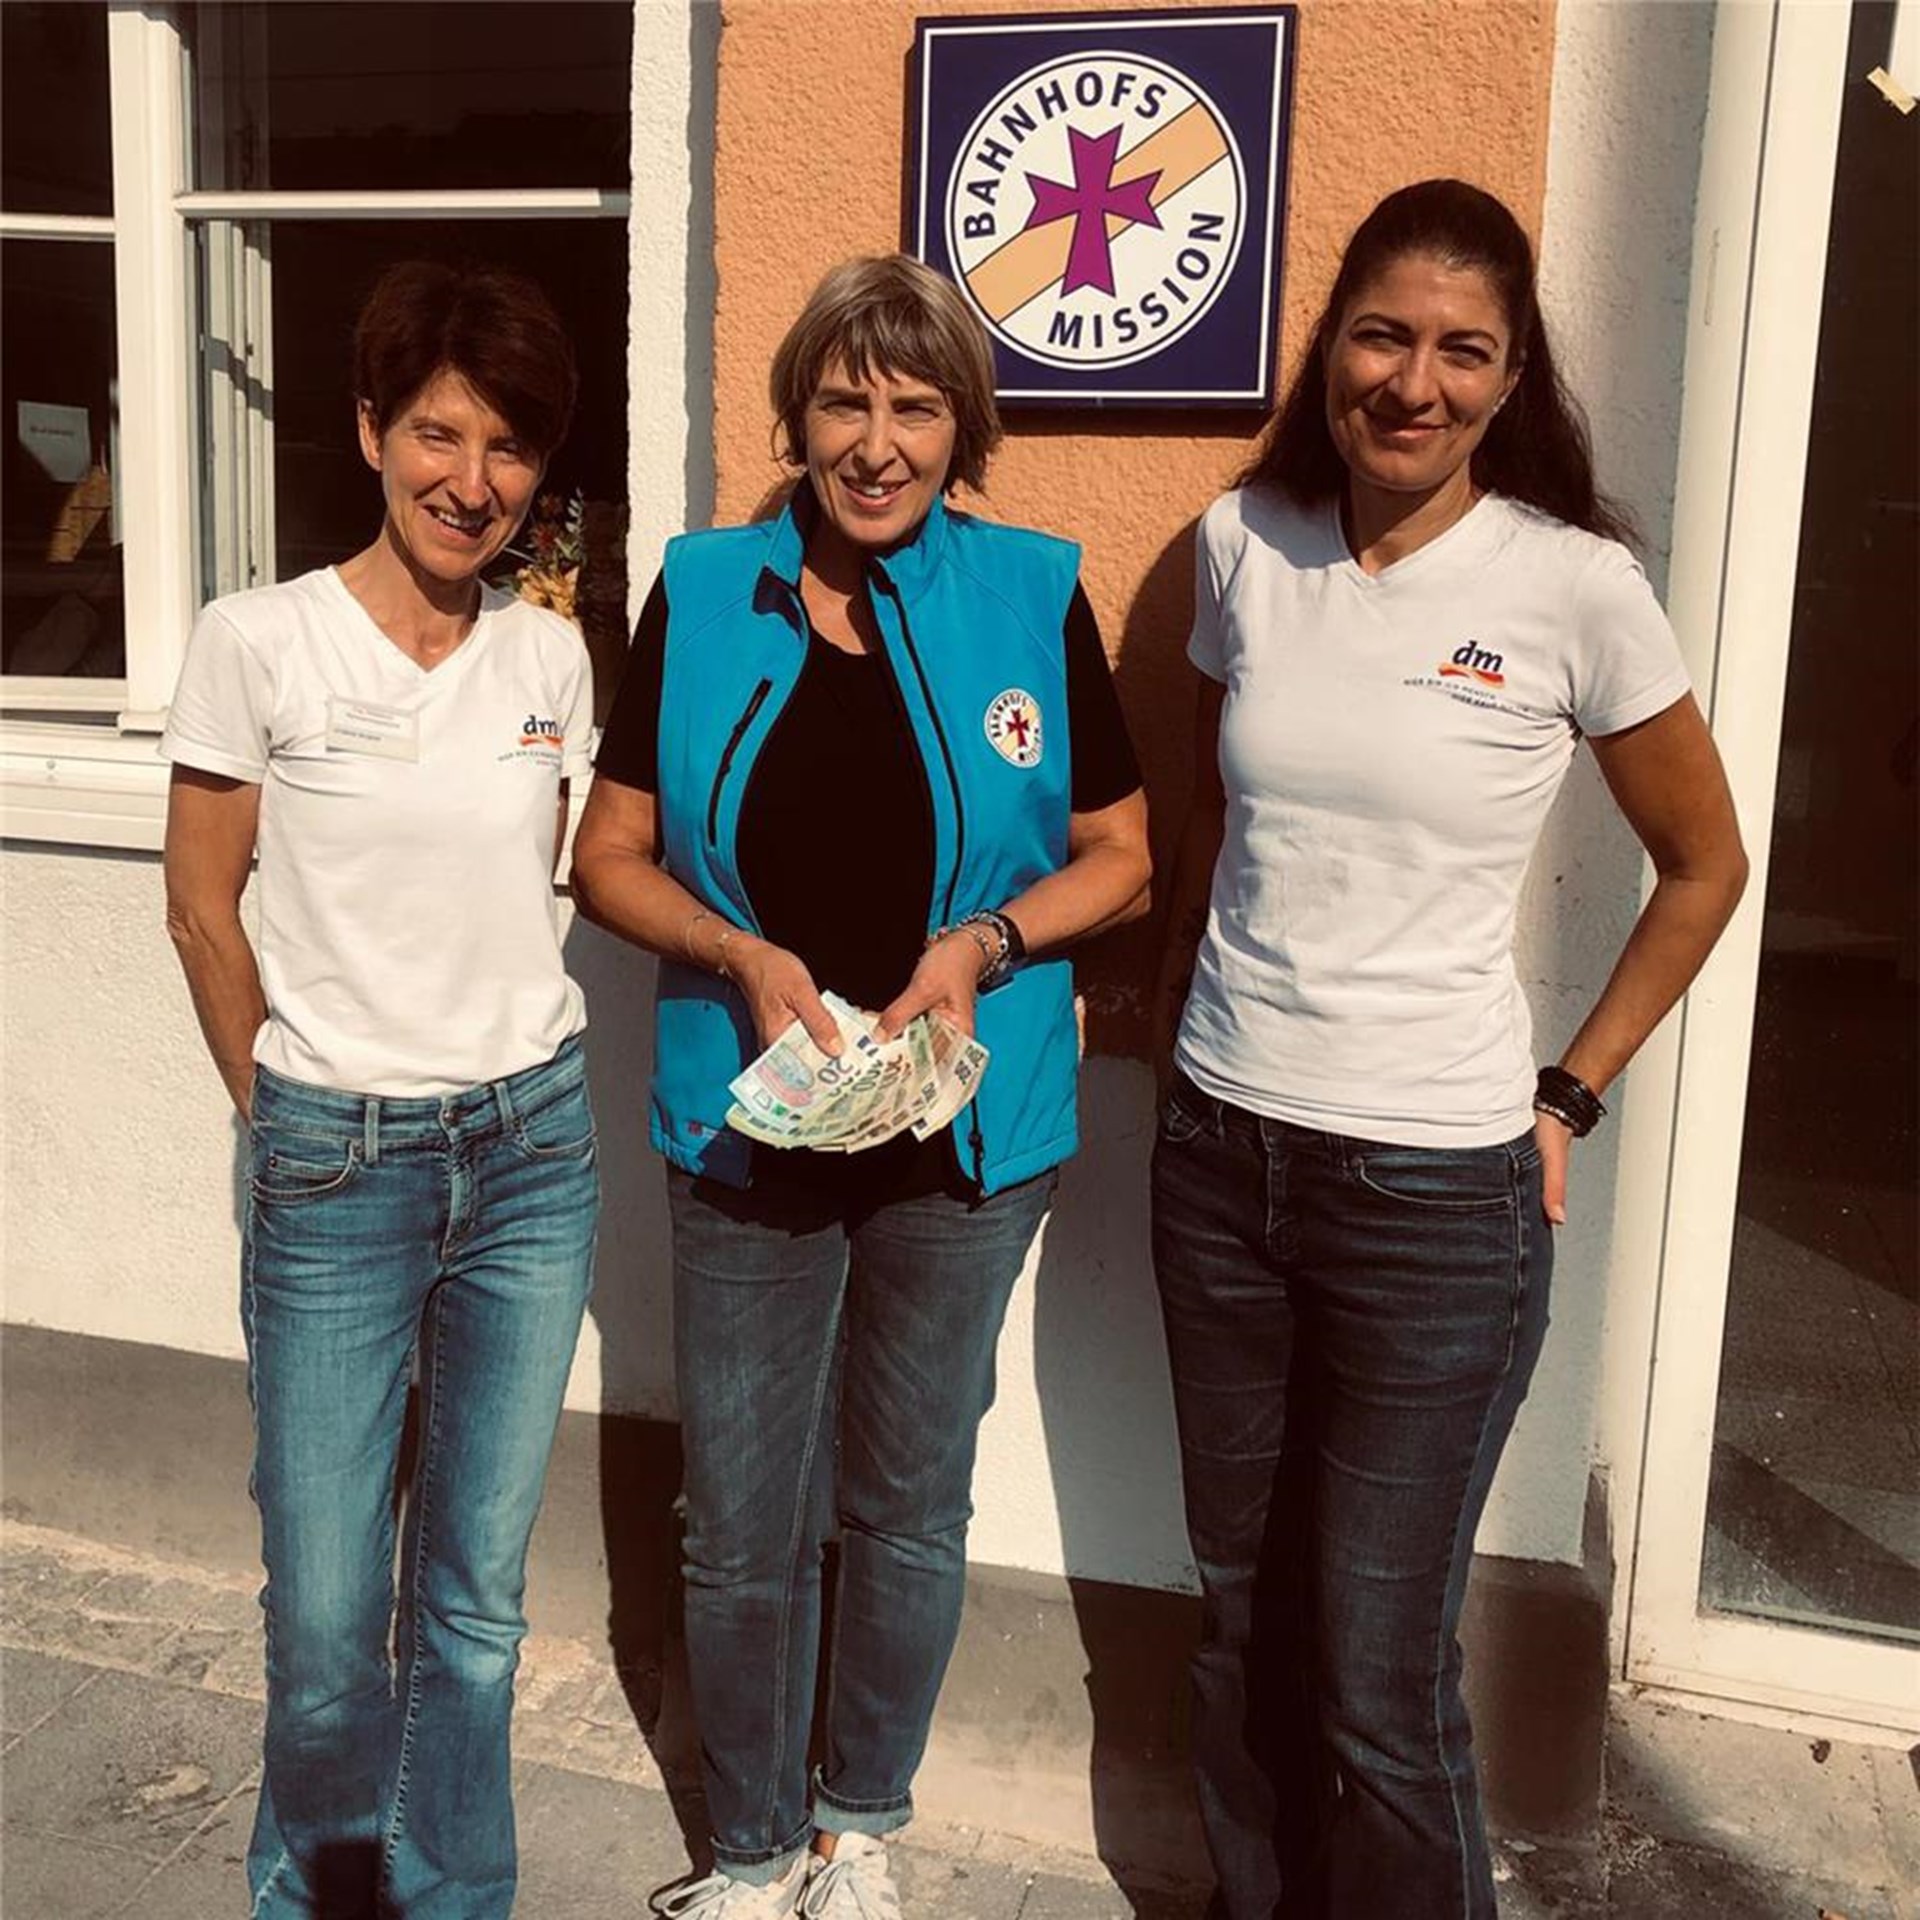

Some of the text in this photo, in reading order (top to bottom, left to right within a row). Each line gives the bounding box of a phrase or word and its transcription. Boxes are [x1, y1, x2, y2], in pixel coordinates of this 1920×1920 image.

[963, 70, 1167, 239] BAHNHOFS
[1047, 211, 1225, 349] MISSION
[1452, 639, 1504, 673] dm
[522, 714, 559, 736] dm
